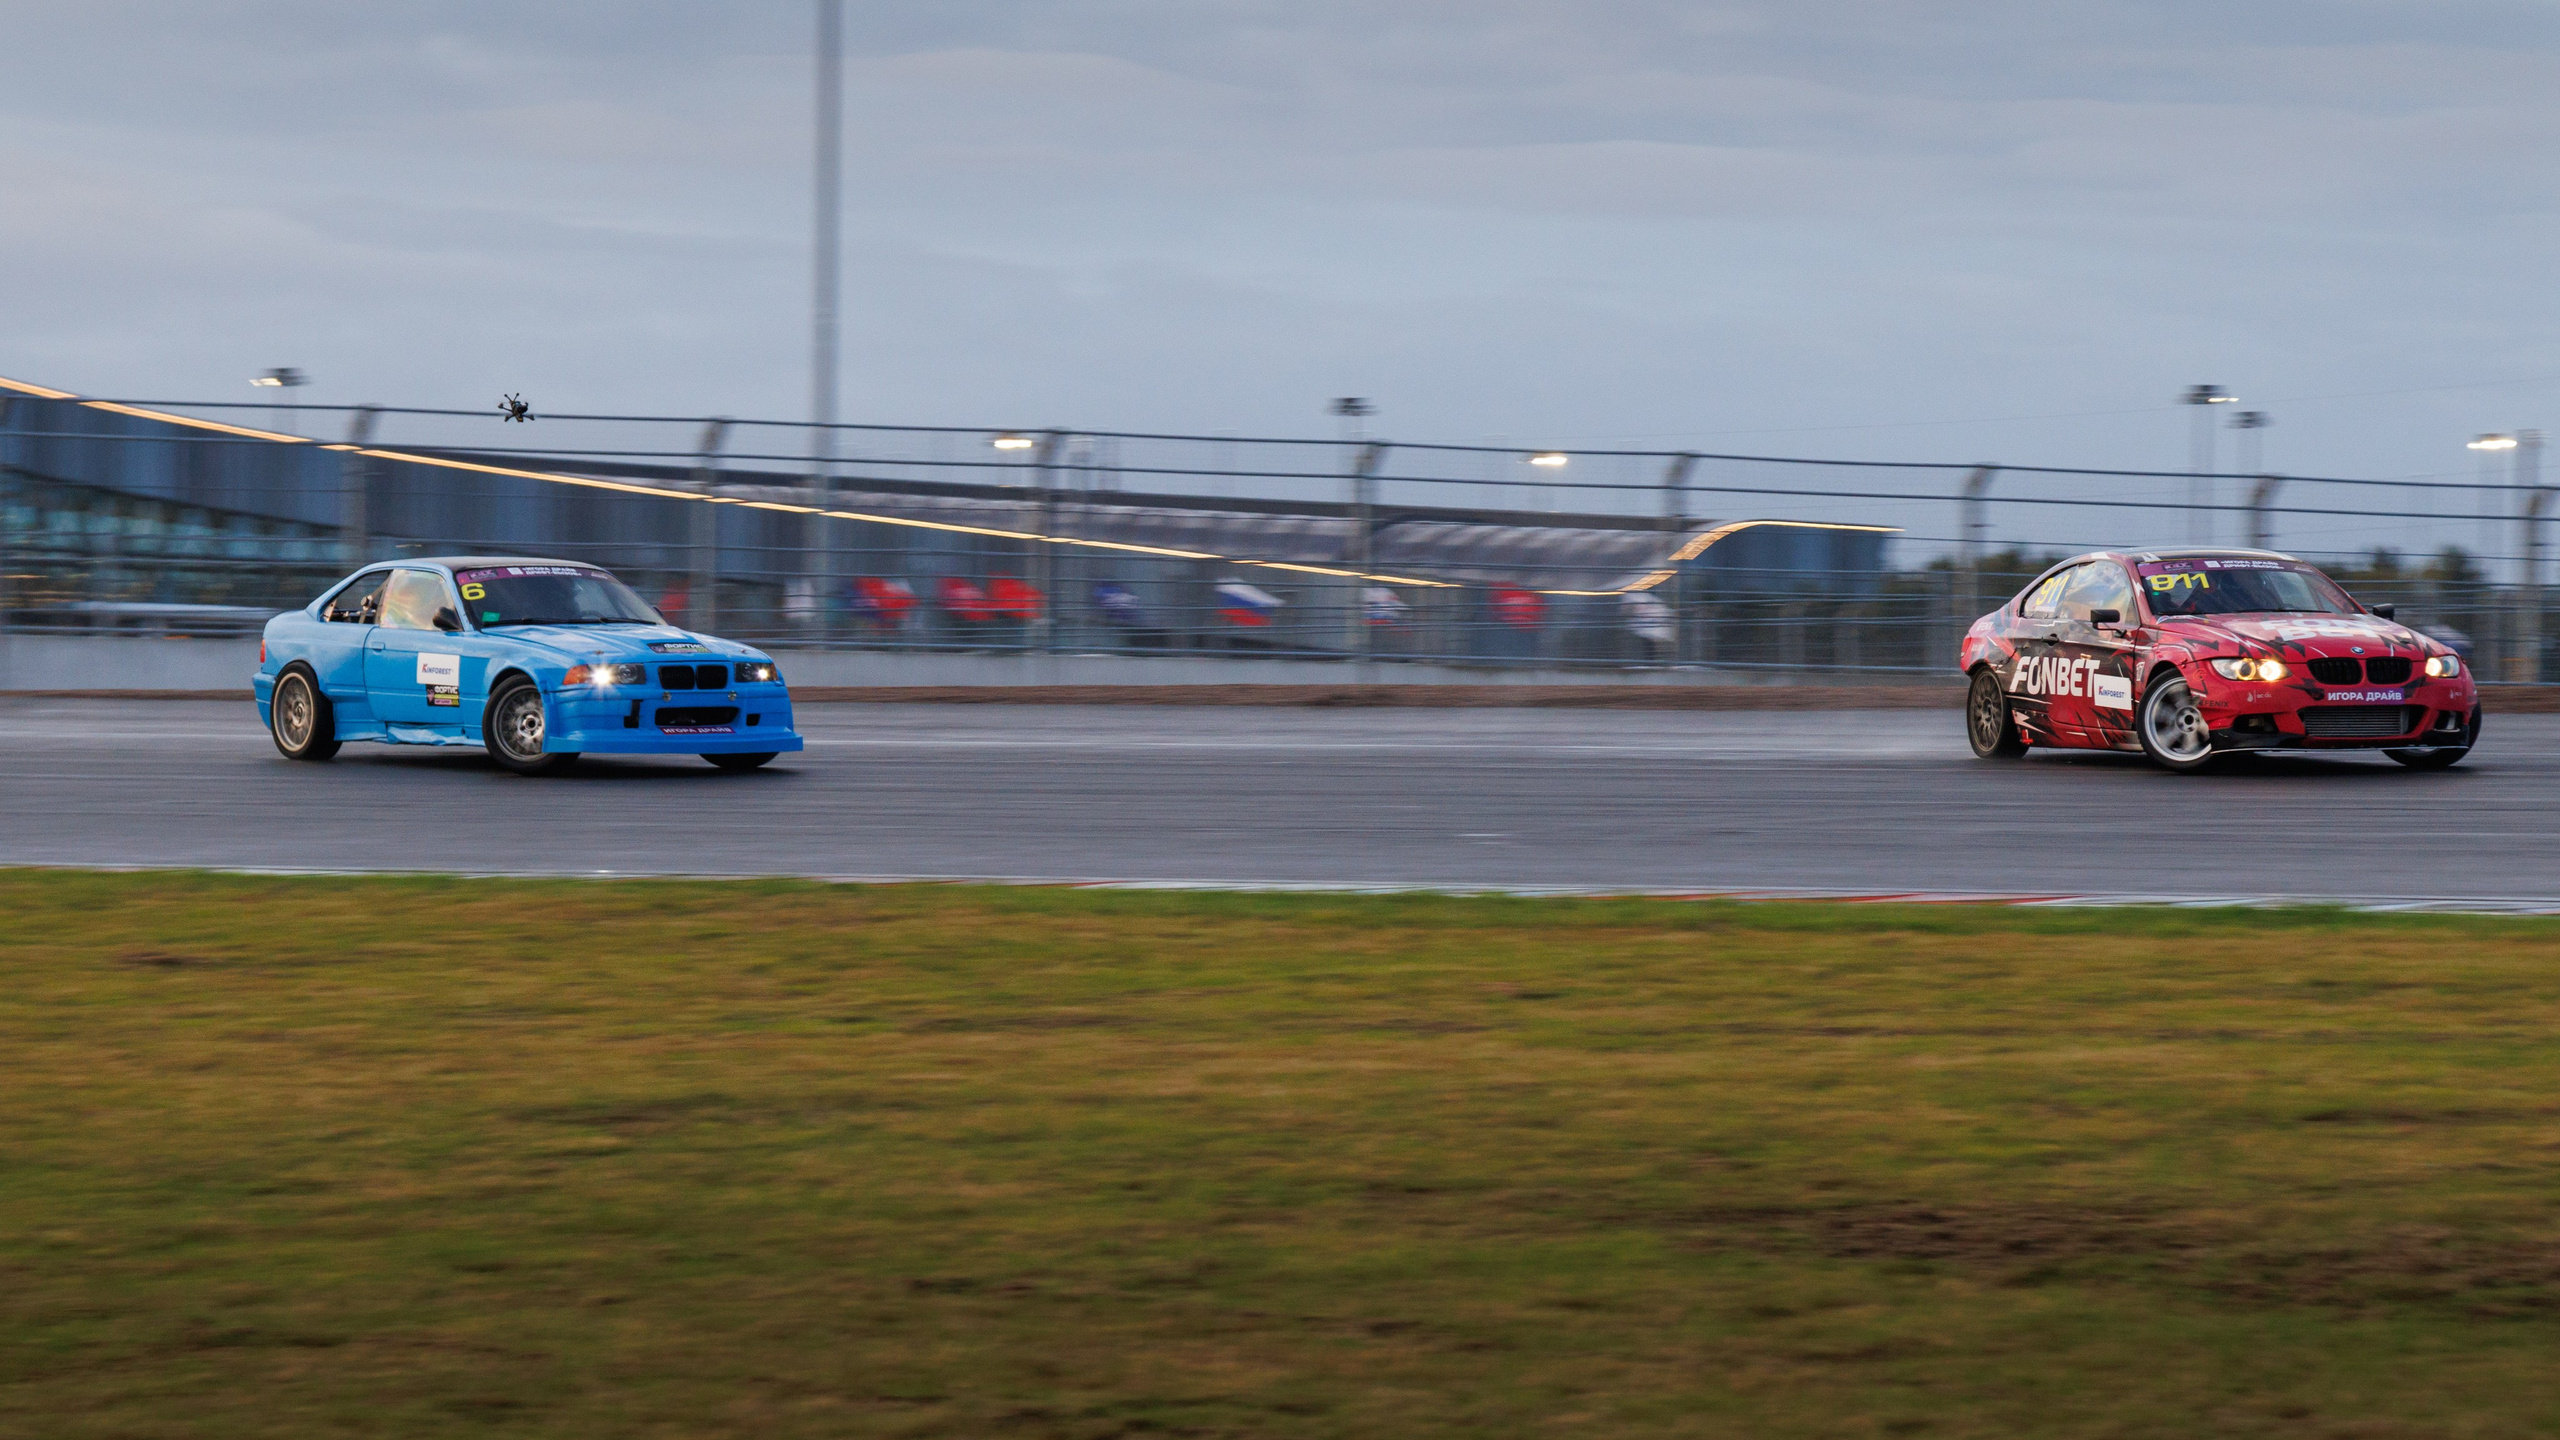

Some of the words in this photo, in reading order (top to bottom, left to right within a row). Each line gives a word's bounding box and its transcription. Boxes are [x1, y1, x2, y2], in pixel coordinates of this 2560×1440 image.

[461, 582, 486, 600] 6
[2035, 574, 2070, 606] 911
[2150, 573, 2210, 591] 911
[422, 663, 452, 675] KINFOREST
[2008, 656, 2101, 698] FONBET
[2098, 685, 2125, 699] KINFOREST
[2327, 691, 2364, 701] ИГОРА
[2365, 690, 2403, 702] ДРАЙВ
